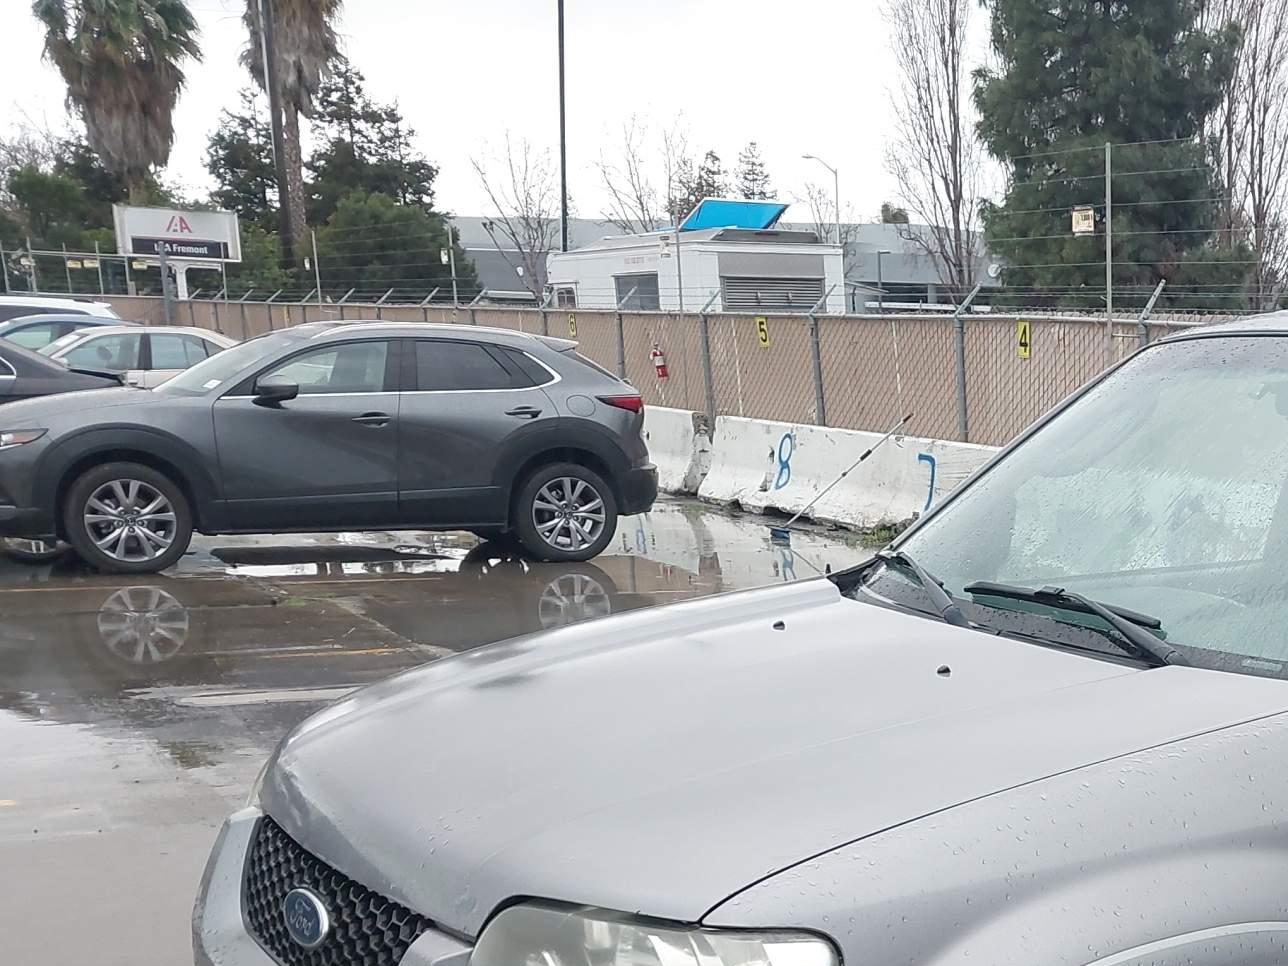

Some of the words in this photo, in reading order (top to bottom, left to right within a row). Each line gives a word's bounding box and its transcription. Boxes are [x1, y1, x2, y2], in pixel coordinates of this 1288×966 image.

[173, 245, 208, 254] Fremont
[758, 320, 768, 343] 5
[1019, 324, 1029, 353] 4
[774, 433, 793, 490] 8
